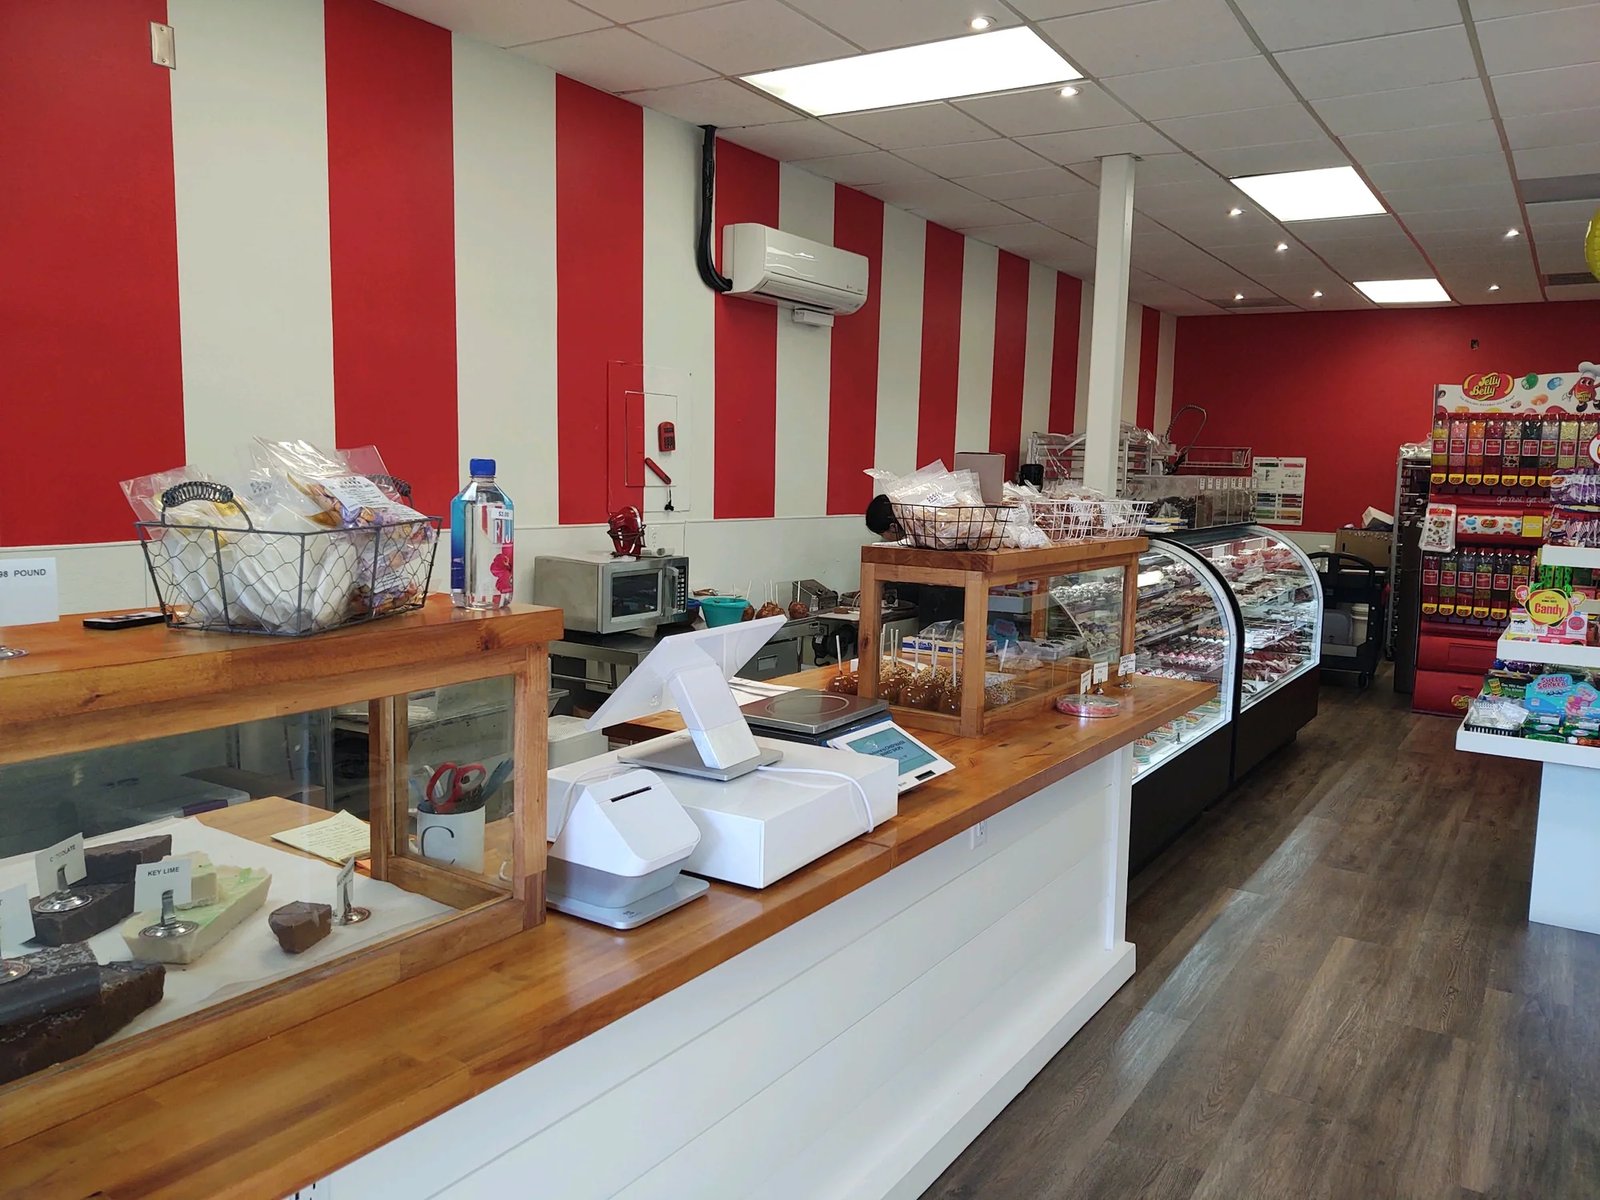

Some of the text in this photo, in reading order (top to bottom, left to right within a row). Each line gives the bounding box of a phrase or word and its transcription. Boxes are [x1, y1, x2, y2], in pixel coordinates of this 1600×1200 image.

[1479, 374, 1502, 388] Jelly
[1470, 384, 1496, 397] Belly
[494, 519, 512, 543] FIJ
[13, 568, 47, 577] POUND
[1534, 602, 1565, 618] Candy
[147, 866, 180, 877] KEY LIME
